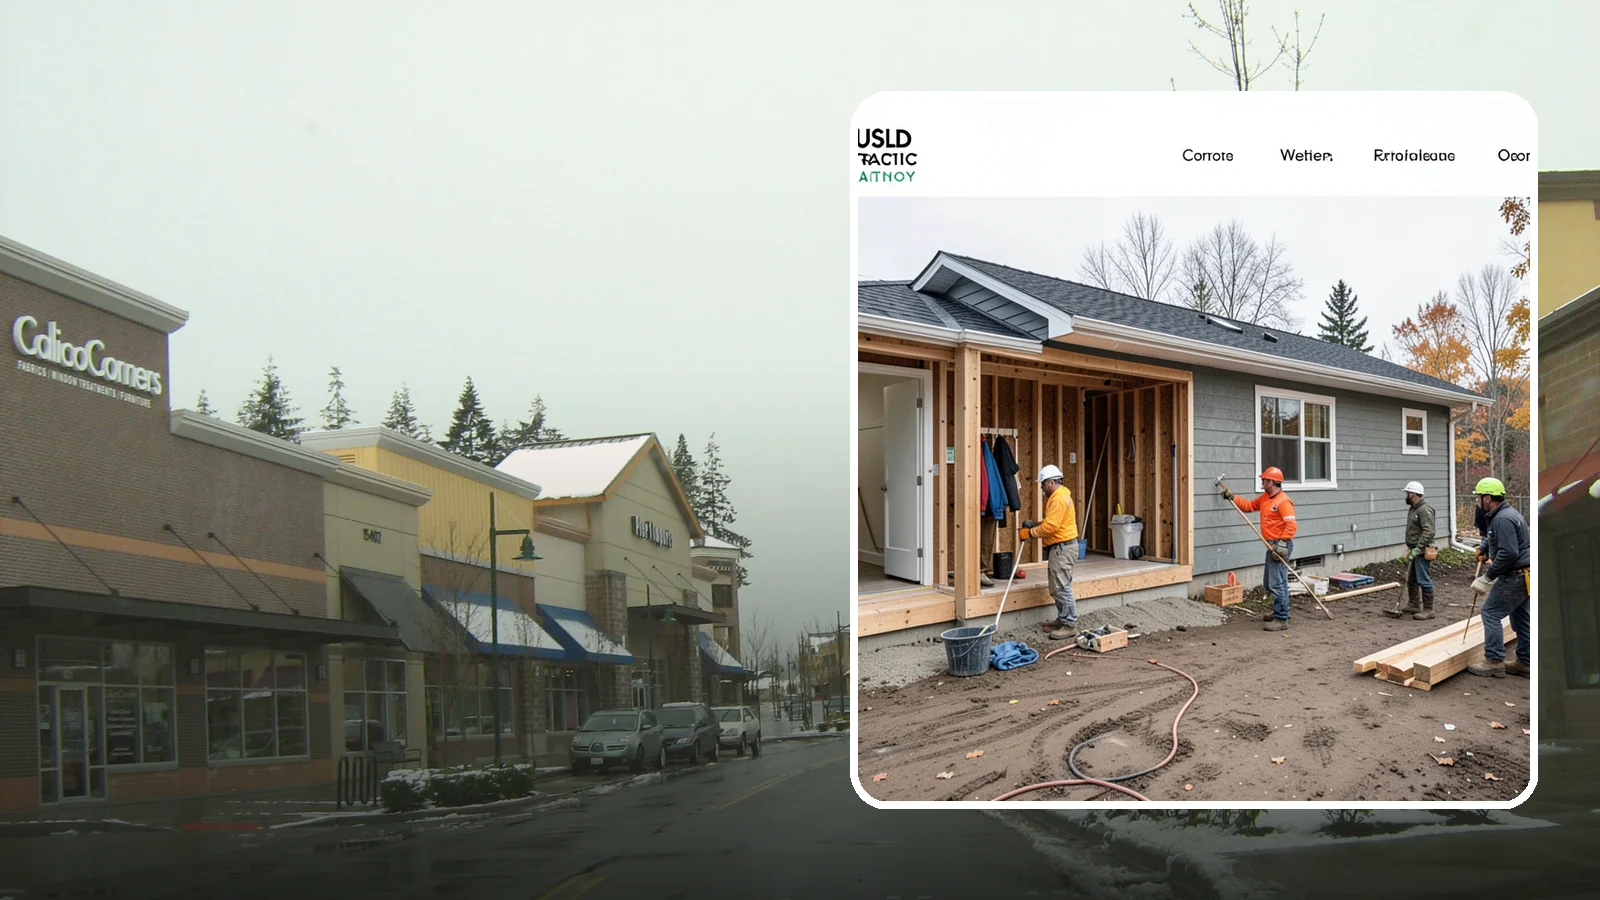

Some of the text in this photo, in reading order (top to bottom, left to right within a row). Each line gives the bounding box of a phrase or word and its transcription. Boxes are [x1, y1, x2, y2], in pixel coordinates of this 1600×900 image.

[17, 360, 151, 408] FABRICS WINDOW TREATMENTS FURNITURE
